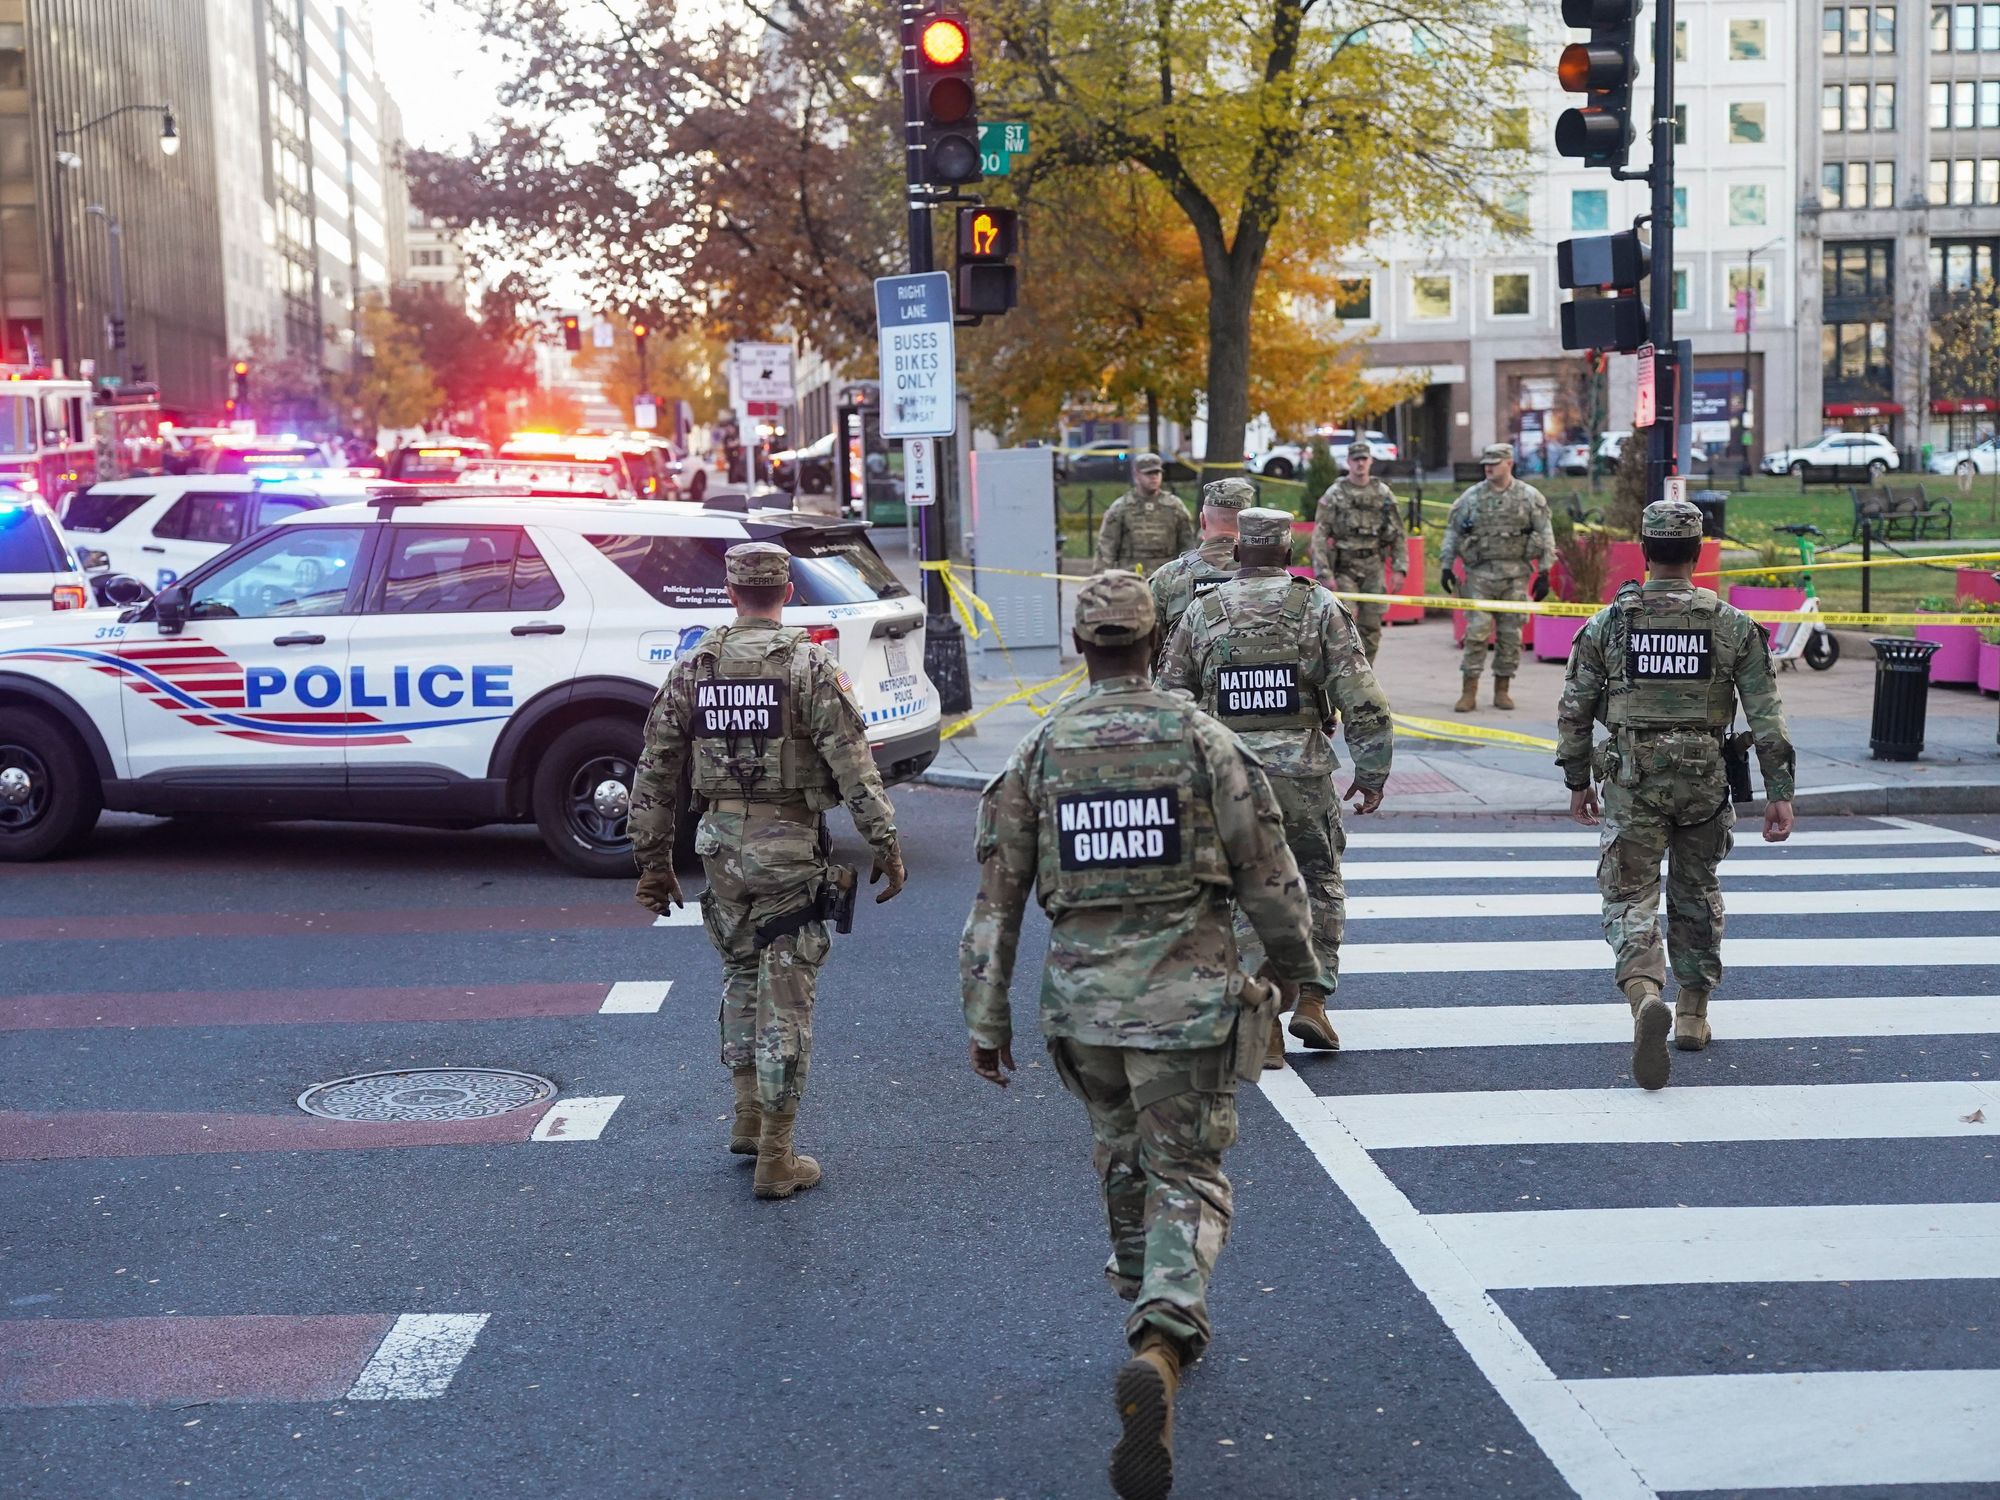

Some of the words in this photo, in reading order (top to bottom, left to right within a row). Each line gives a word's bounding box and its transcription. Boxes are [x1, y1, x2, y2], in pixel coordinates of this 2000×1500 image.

[1005, 125, 1023, 139] ST
[1005, 139, 1024, 152] NW
[897, 284, 926, 300] RIGHT
[900, 303, 927, 320] LANE
[894, 332, 937, 351] BUSES
[895, 353, 938, 371] BIKES
[897, 372, 936, 389] ONLY
[1250, 537, 1269, 545] SMITH
[748, 576, 775, 585] PERRY
[663, 585, 690, 594] Policing
[675, 596, 702, 604] Serving
[95, 626, 125, 638] 315
[1633, 634, 1708, 653] NATIONAL
[650, 649, 671, 659] MP
[1638, 655, 1699, 674] GUARD
[246, 664, 513, 708] POLICE
[1220, 669, 1295, 690] NATIONAL
[698, 685, 778, 707] NATIONAL
[894, 689, 913, 703] POLICE
[1229, 690, 1287, 710] GUARD
[705, 709, 769, 731] GUARD
[1061, 797, 1175, 831] NATIONAL
[1074, 829, 1164, 862] GUARD
